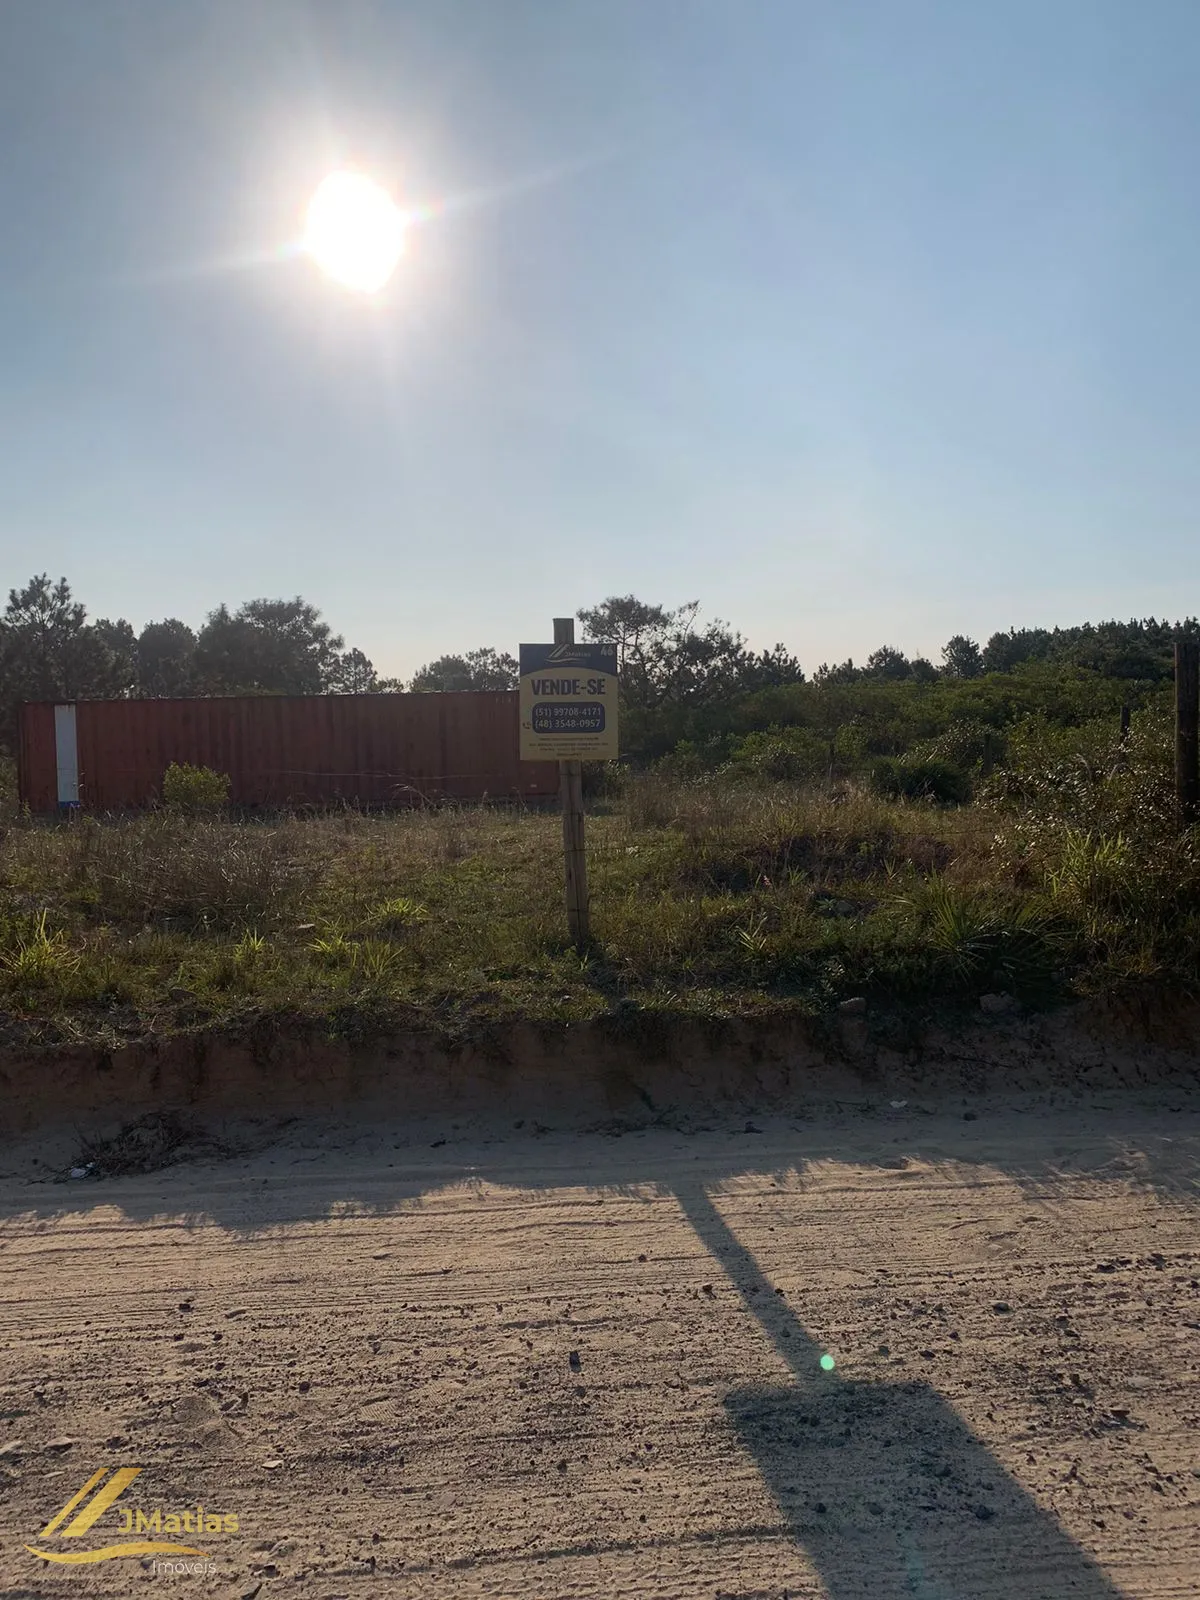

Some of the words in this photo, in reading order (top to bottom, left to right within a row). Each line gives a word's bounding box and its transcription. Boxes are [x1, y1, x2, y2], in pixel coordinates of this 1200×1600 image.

[531, 679, 606, 695] VENDE-SE
[535, 707, 552, 717] (51)
[554, 707, 601, 716] 99708-4171
[535, 719, 552, 729] (48)
[554, 719, 601, 728] 3548-0957
